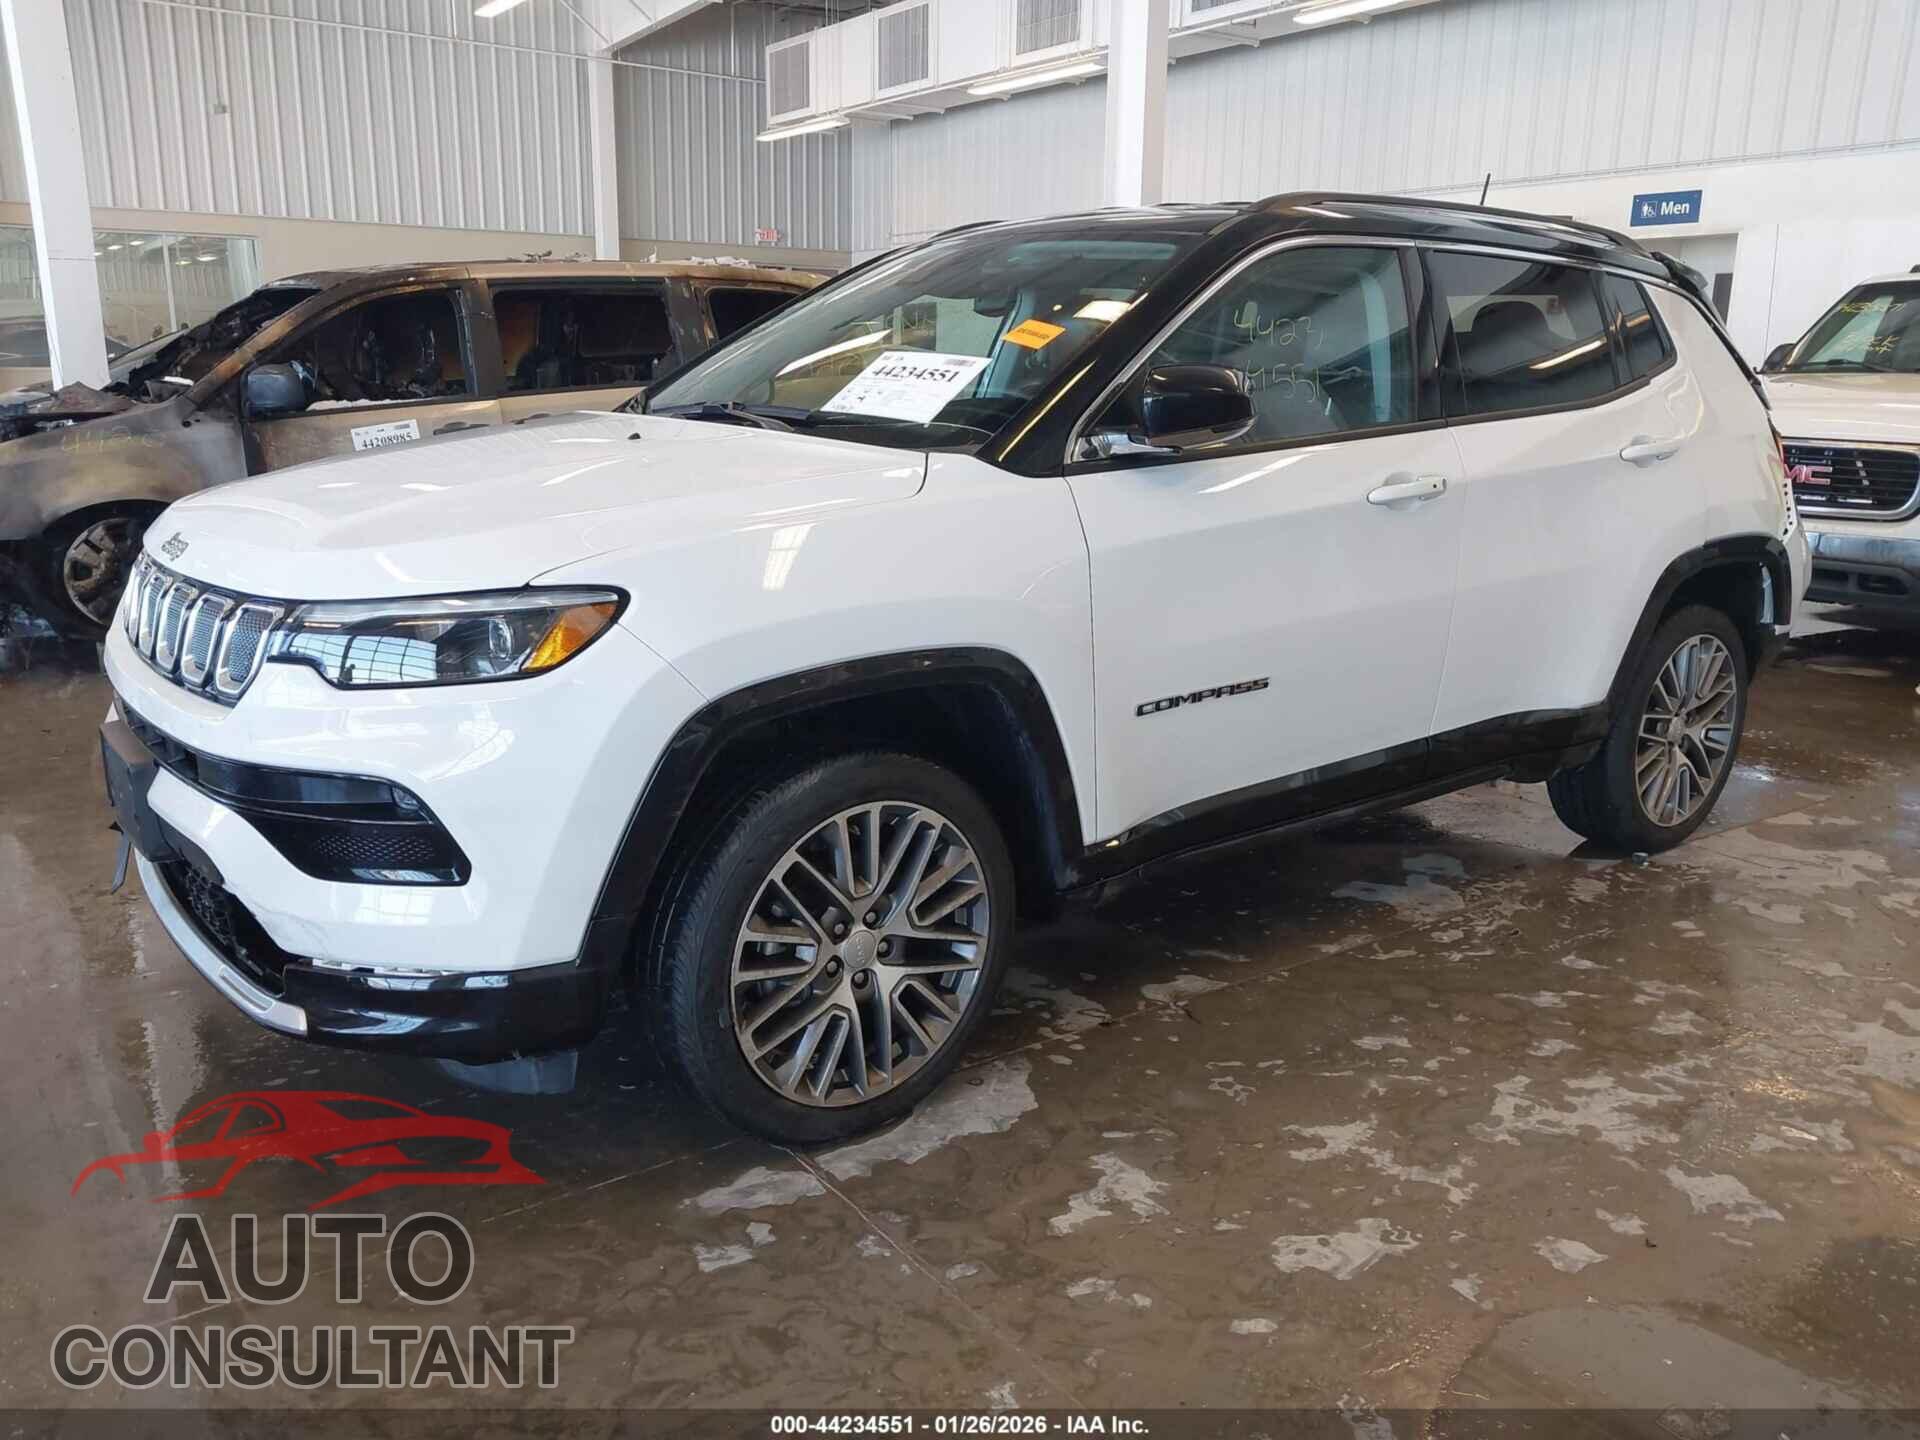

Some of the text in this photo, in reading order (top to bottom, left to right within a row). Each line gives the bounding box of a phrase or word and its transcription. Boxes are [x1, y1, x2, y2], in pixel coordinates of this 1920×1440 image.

[1660, 200, 1690, 216] Men
[872, 365, 960, 383] 44234551
[1136, 677, 1270, 717] COMPASS
